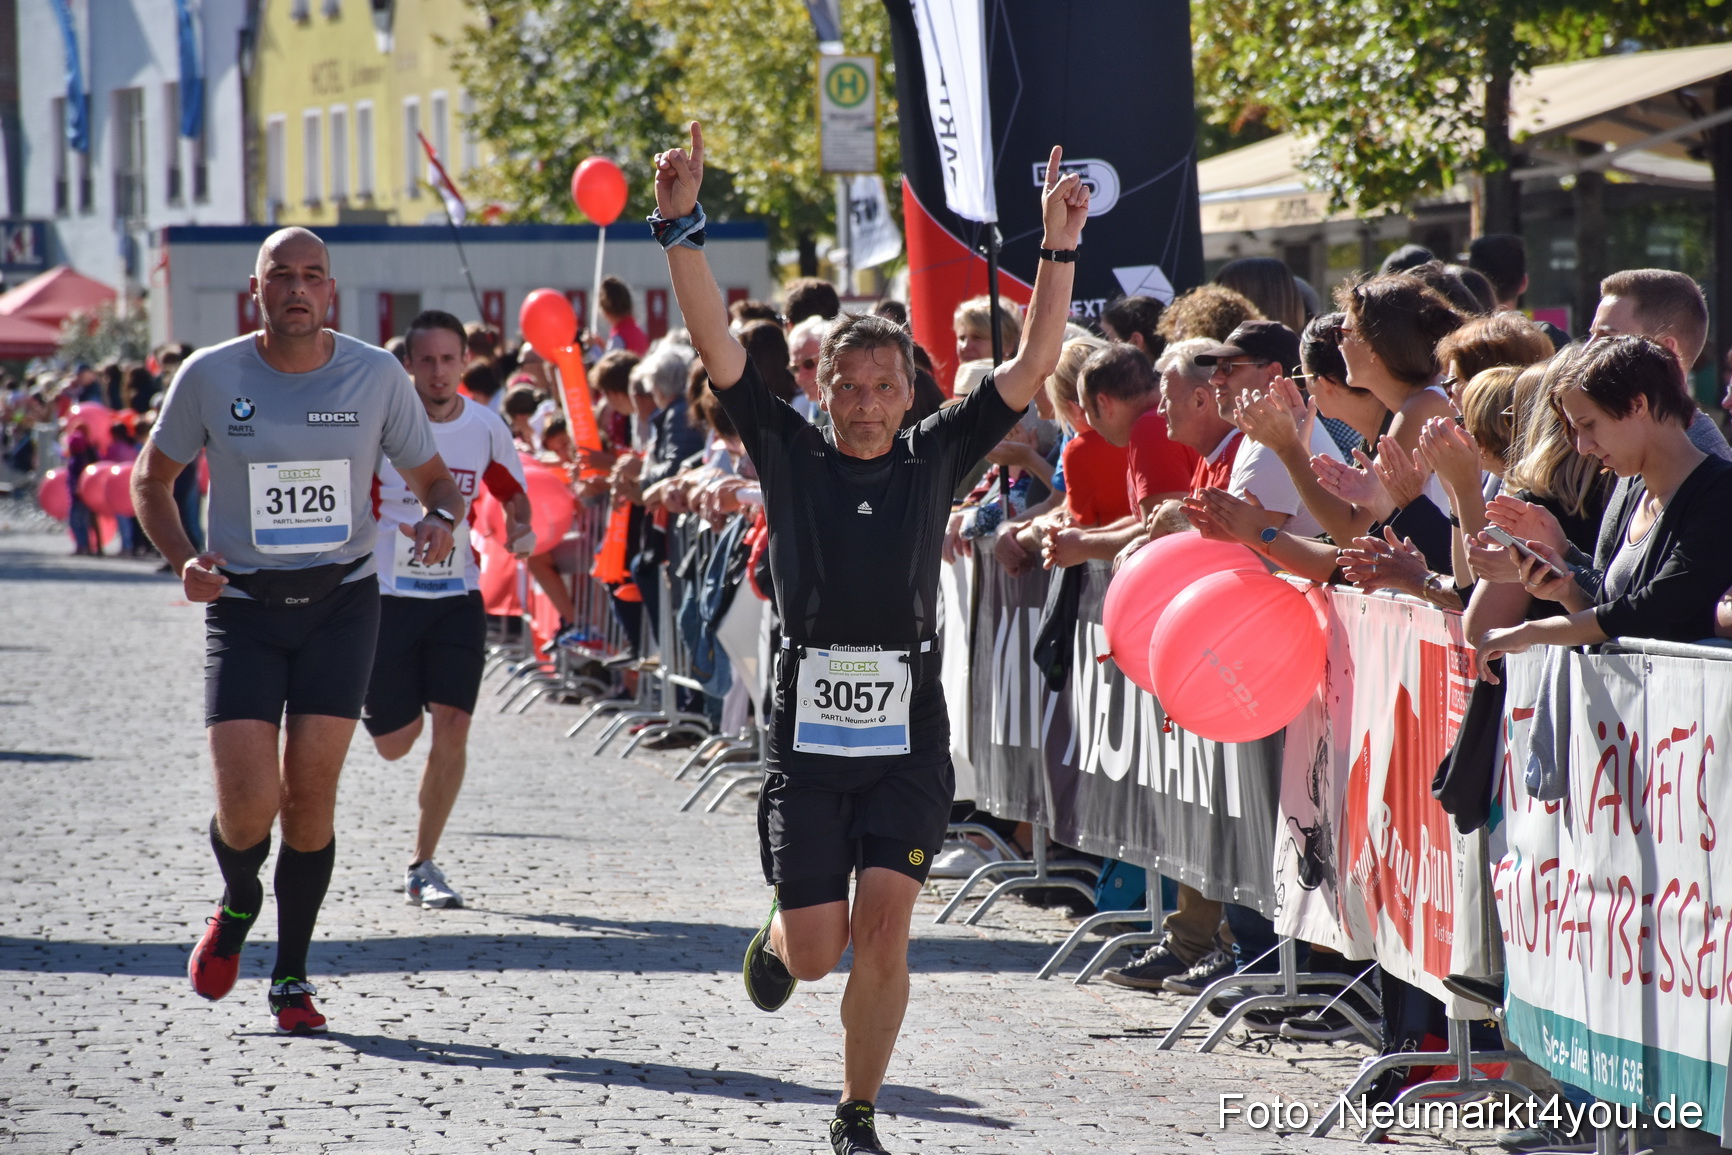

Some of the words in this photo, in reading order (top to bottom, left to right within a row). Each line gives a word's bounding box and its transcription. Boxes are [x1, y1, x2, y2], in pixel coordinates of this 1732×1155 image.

[307, 412, 359, 423] BOCK
[228, 425, 255, 433] PARTL
[279, 469, 321, 479] BOCK
[266, 485, 336, 515] 3126
[829, 643, 877, 652] Continental
[829, 660, 880, 672] BOCK
[813, 678, 895, 713] 3057
[820, 713, 844, 722] PARTL
[844, 716, 877, 724] Neumarkt
